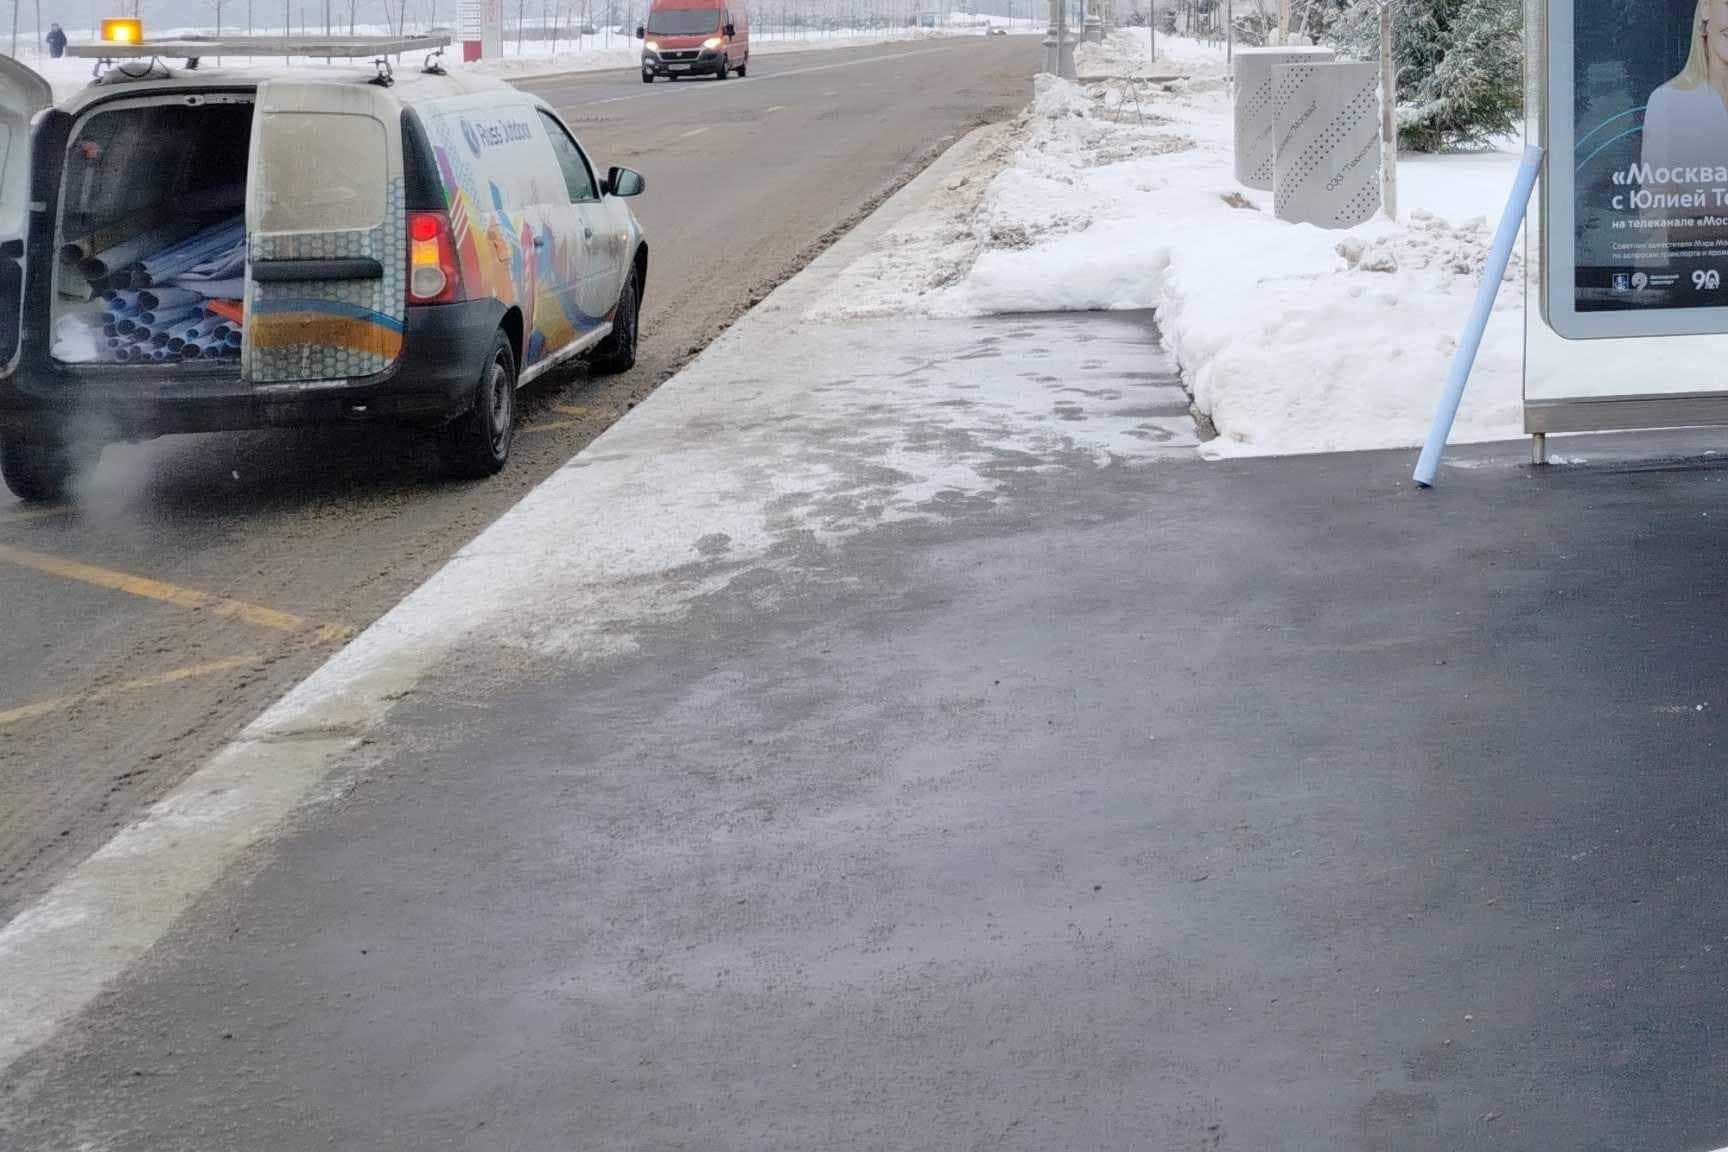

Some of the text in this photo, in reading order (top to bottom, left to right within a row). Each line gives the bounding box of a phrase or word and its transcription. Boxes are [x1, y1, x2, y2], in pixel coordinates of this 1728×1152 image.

[1612, 163, 1728, 186] «Москва
[1612, 196, 1622, 209] с
[1630, 188, 1706, 210] Юлией
[1612, 221, 1625, 229] на
[1628, 218, 1694, 228] телеканале
